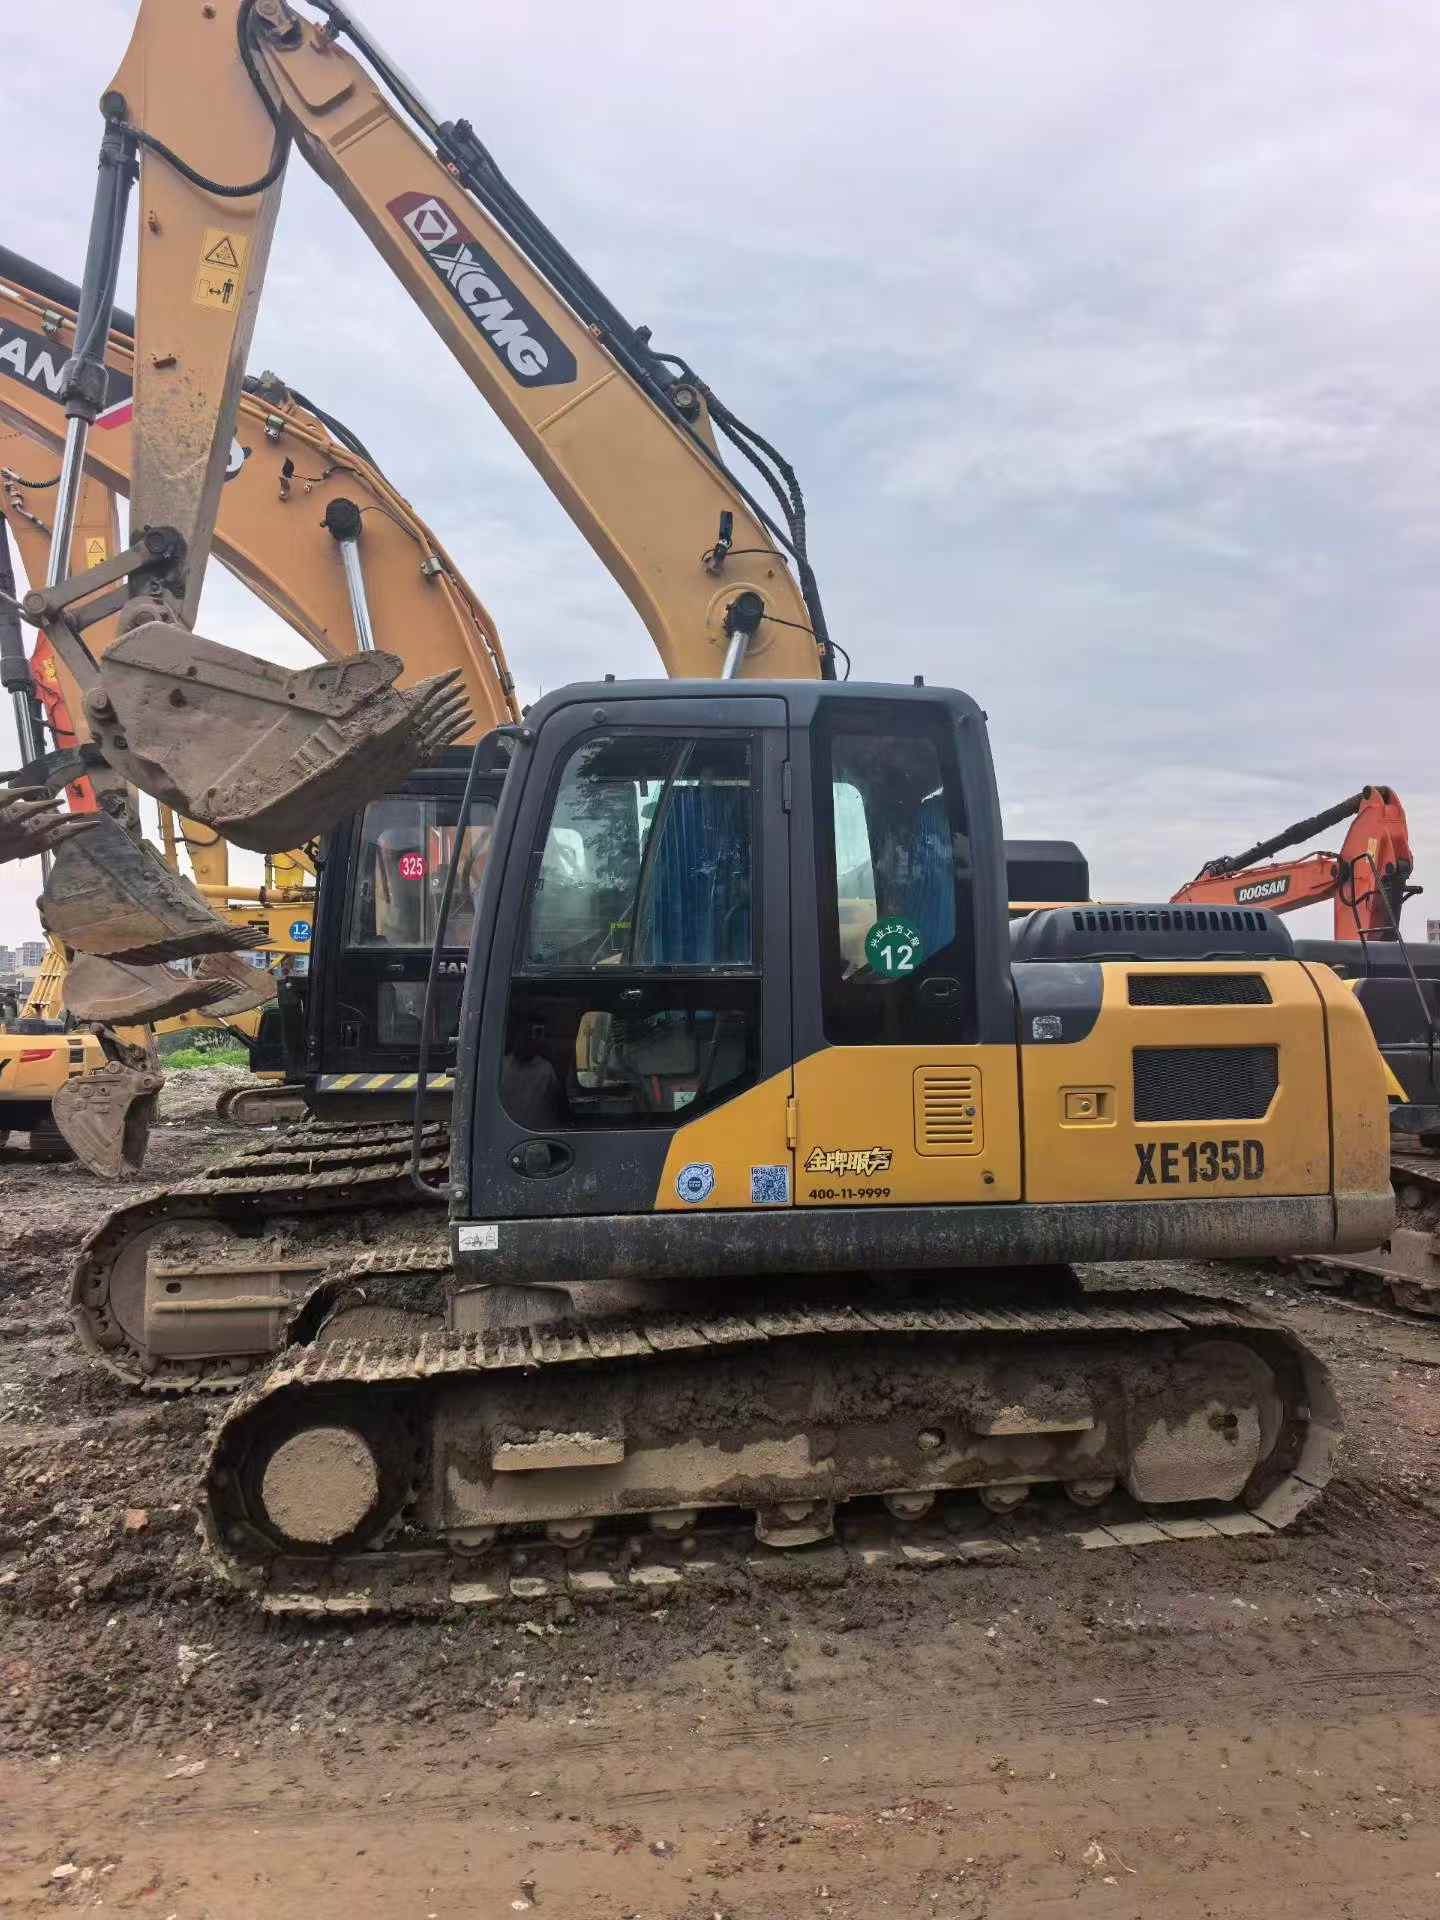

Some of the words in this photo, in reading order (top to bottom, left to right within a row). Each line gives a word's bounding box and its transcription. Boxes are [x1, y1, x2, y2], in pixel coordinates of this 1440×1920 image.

[428, 243, 549, 377] XCMG
[402, 857, 423, 876] 325
[1239, 879, 1286, 902] DOOSAN
[293, 923, 309, 935] 12
[880, 945, 914, 970] 12
[804, 1146, 893, 1177] 金牌服务
[1134, 1139, 1265, 1185] XE135D
[808, 1187, 891, 1200] 400-11-9999
